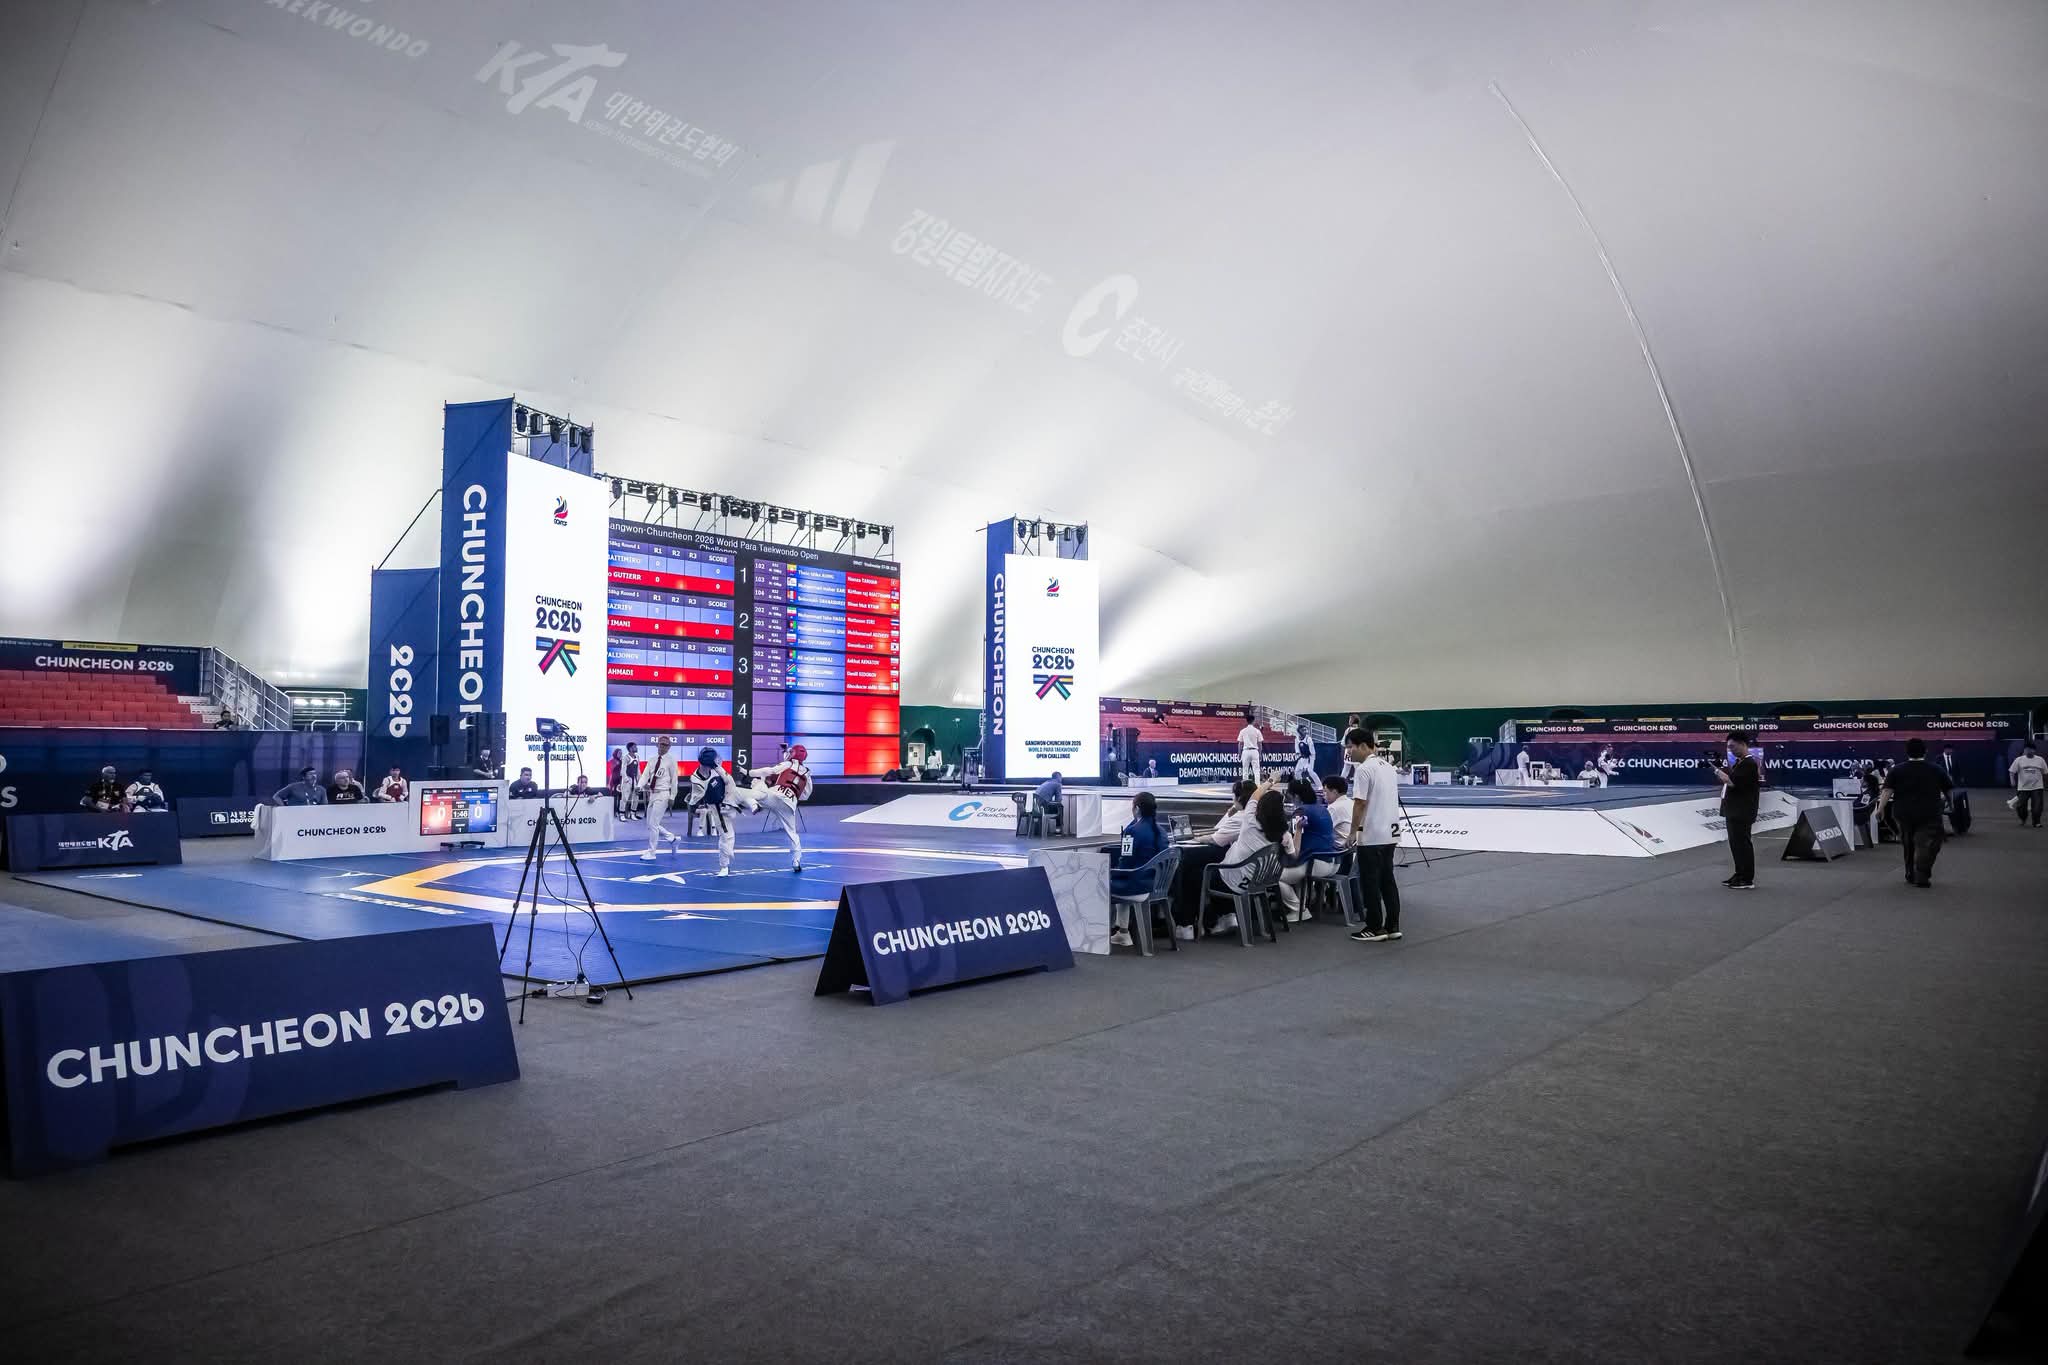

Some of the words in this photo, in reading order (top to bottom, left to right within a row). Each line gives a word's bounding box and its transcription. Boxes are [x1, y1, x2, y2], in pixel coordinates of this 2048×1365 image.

[475, 40, 629, 122] KTA
[694, 534, 715, 546] 2026
[716, 537, 739, 549] World
[740, 541, 757, 551] Para
[759, 543, 799, 558] Taekwondo
[800, 550, 819, 561] Open
[708, 554, 728, 563] SCORE
[739, 568, 747, 583] 1
[535, 594, 583, 611] CHUNCHEON
[739, 612, 749, 629] 2
[993, 573, 1005, 735] CHUNCHEON
[1031, 646, 1075, 655] CHUNCHEON
[35, 655, 134, 671] CHUNCHEON
[738, 657, 748, 674] 3
[737, 703, 748, 719] 4
[1813, 722, 1866, 730] CHUNCHEON
[737, 749, 748, 766] 5
[1262, 752, 1282, 762] WORLD
[1179, 767, 1232, 778] DEMONSTRATION
[976, 811, 1017, 819] ChunCheo
[297, 827, 361, 837] CHUNCHEON
[97, 830, 134, 851] KTA
[1123, 844, 1131, 852] 17
[872, 915, 1002, 956] CHUNCHEON
[46, 1007, 371, 1089] CHUNCHEON
